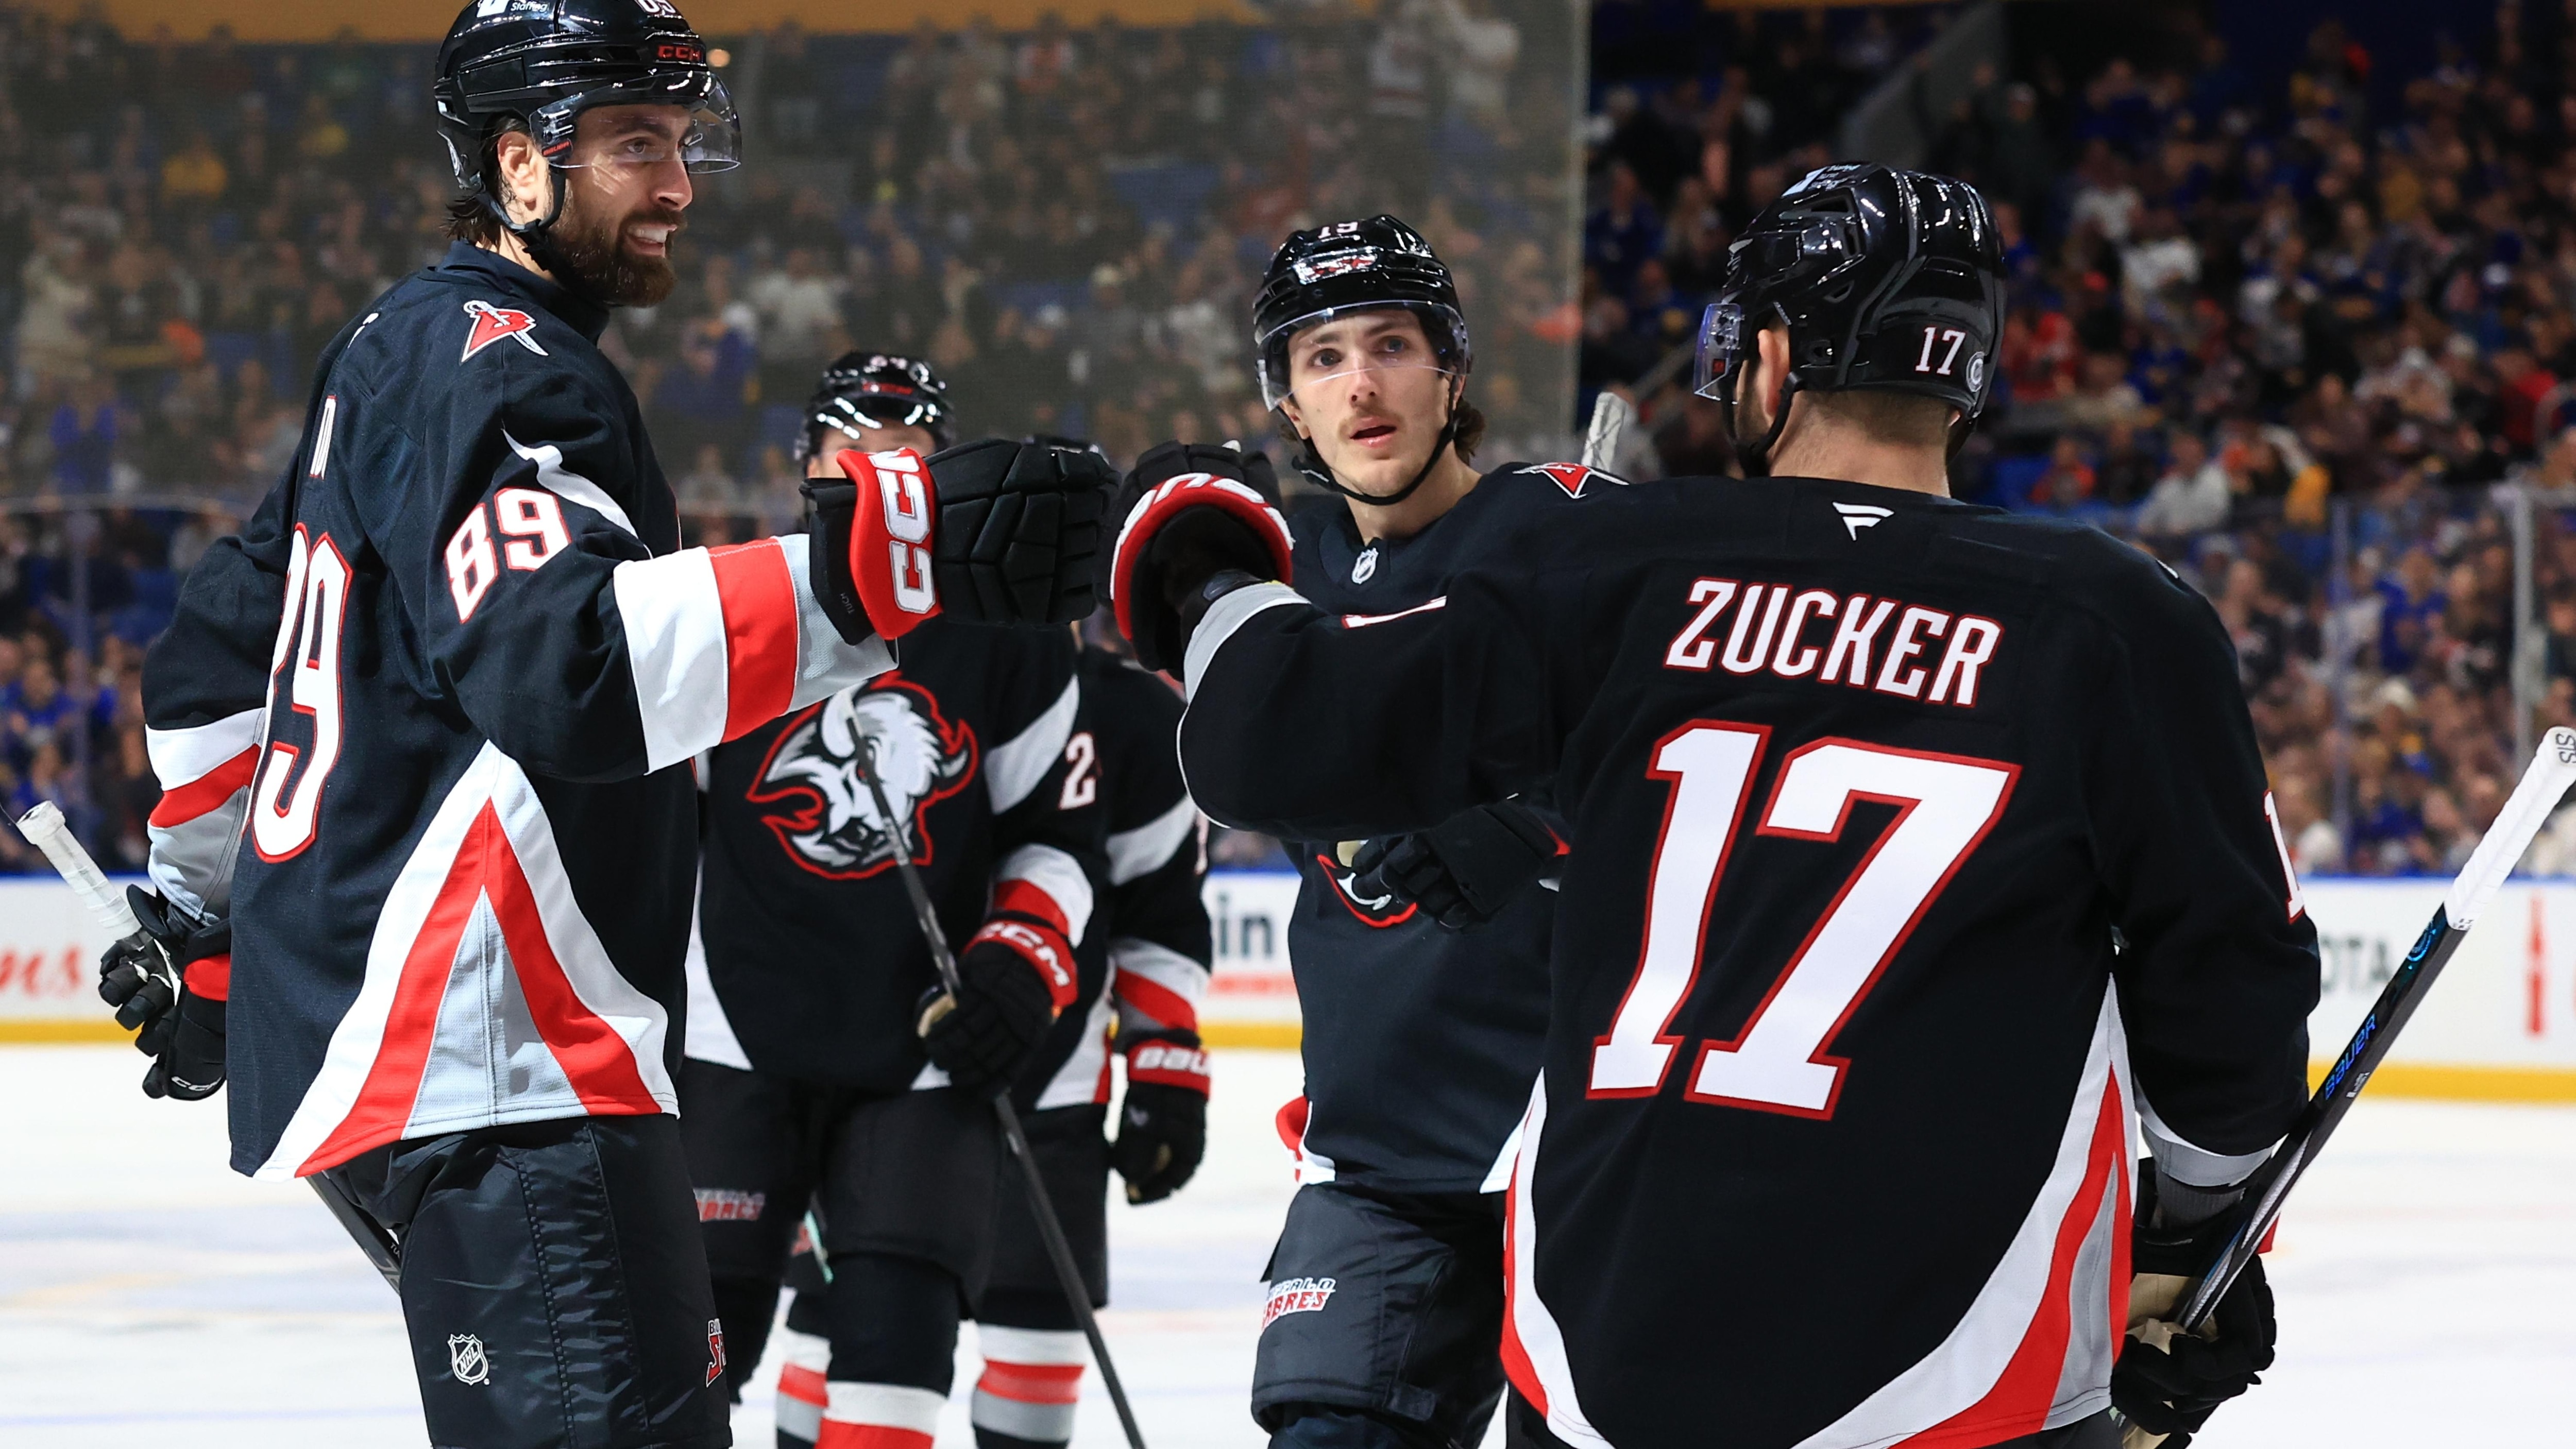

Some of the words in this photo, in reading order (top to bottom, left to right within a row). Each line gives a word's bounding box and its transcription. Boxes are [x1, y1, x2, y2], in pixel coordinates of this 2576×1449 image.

[1915, 326, 1966, 376] 17
[444, 487, 571, 624] 89
[1664, 576, 2005, 708] ZUCKER
[1587, 719, 2023, 1121] 17
[459, 1345, 478, 1374] NHL
